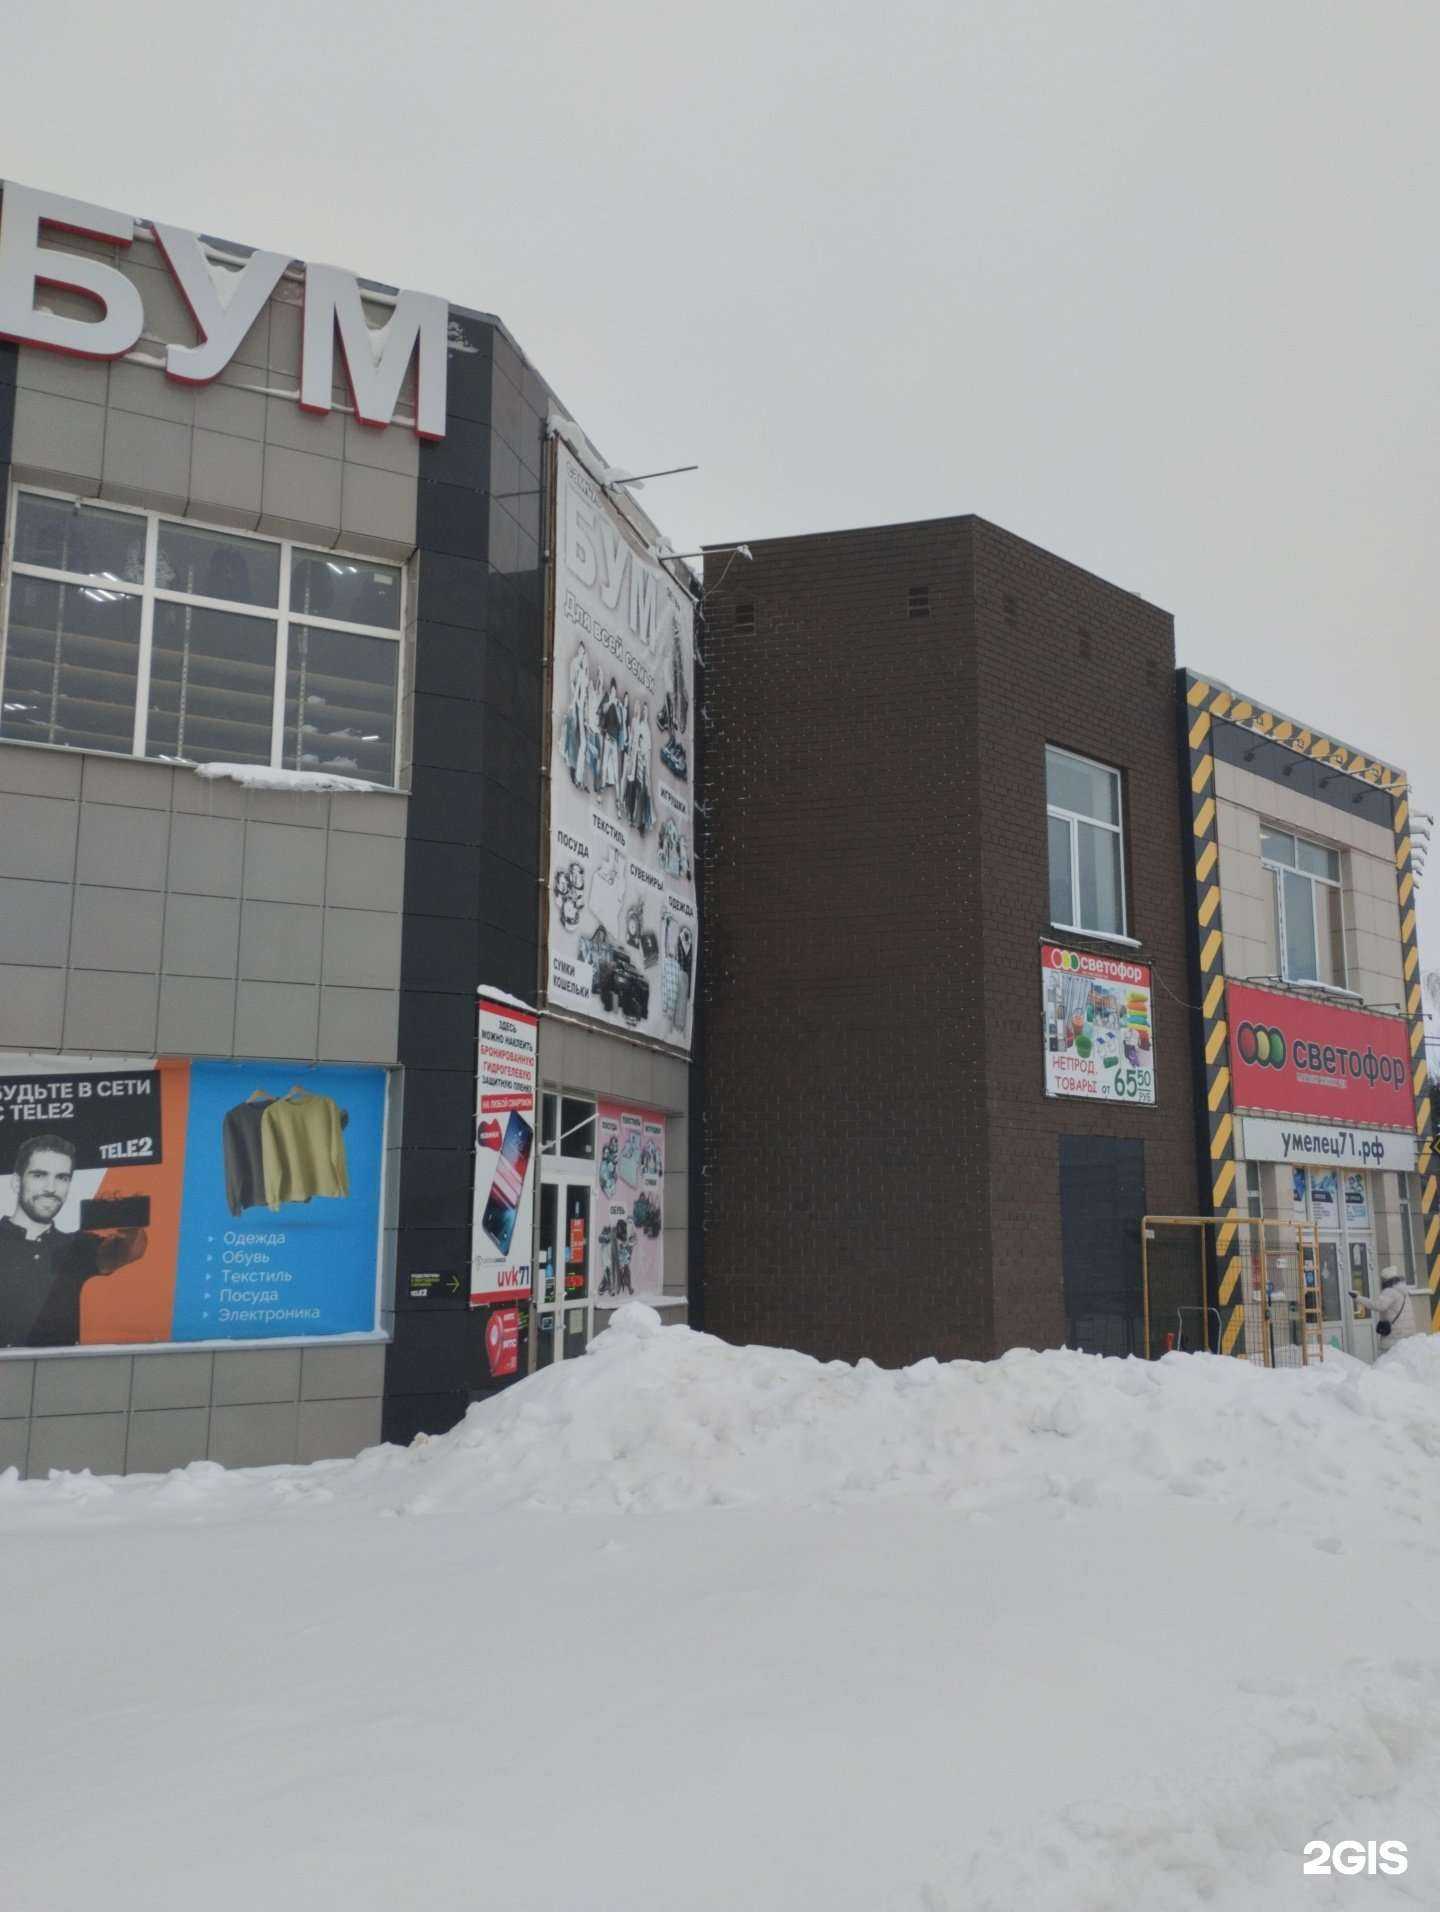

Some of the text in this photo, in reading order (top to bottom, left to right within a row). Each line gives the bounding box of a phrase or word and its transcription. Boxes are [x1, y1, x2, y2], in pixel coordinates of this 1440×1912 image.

[0, 178, 449, 442] БУМ
[564, 485, 658, 656] БУМ
[593, 620, 623, 662] всей
[593, 814, 626, 846] ТЕКСТИЛЬ
[557, 830, 589, 858] ПОСУДА
[630, 863, 664, 890] СУВЕНИРЫ
[668, 895, 694, 917] ОДЕЖДА
[553, 958, 575, 976] СУМКИ
[1080, 956, 1142, 982] светофор
[553, 976, 590, 999] КОШЕЛЬКИ
[1053, 1056, 1098, 1074] НЕПРОД.
[1292, 1040, 1405, 1090] светофор
[79, 1083, 92, 1098] В
[97, 1080, 151, 1097] СЕТИ
[1055, 1076, 1097, 1093] ТОВАРЫ
[1115, 1069, 1151, 1097] 65 50
[10, 1103, 74, 1121] TELE2
[99, 1137, 153, 1160] TELE2
[1281, 1132, 1385, 1165] умелец71.рф
[223, 1231, 286, 1247] Одежда
[222, 1250, 270, 1267] Обувь
[222, 1269, 293, 1283] Текстиль
[497, 1265, 530, 1288] uvk71
[220, 1288, 279, 1304] Посуда
[219, 1308, 320, 1323] Электроника
